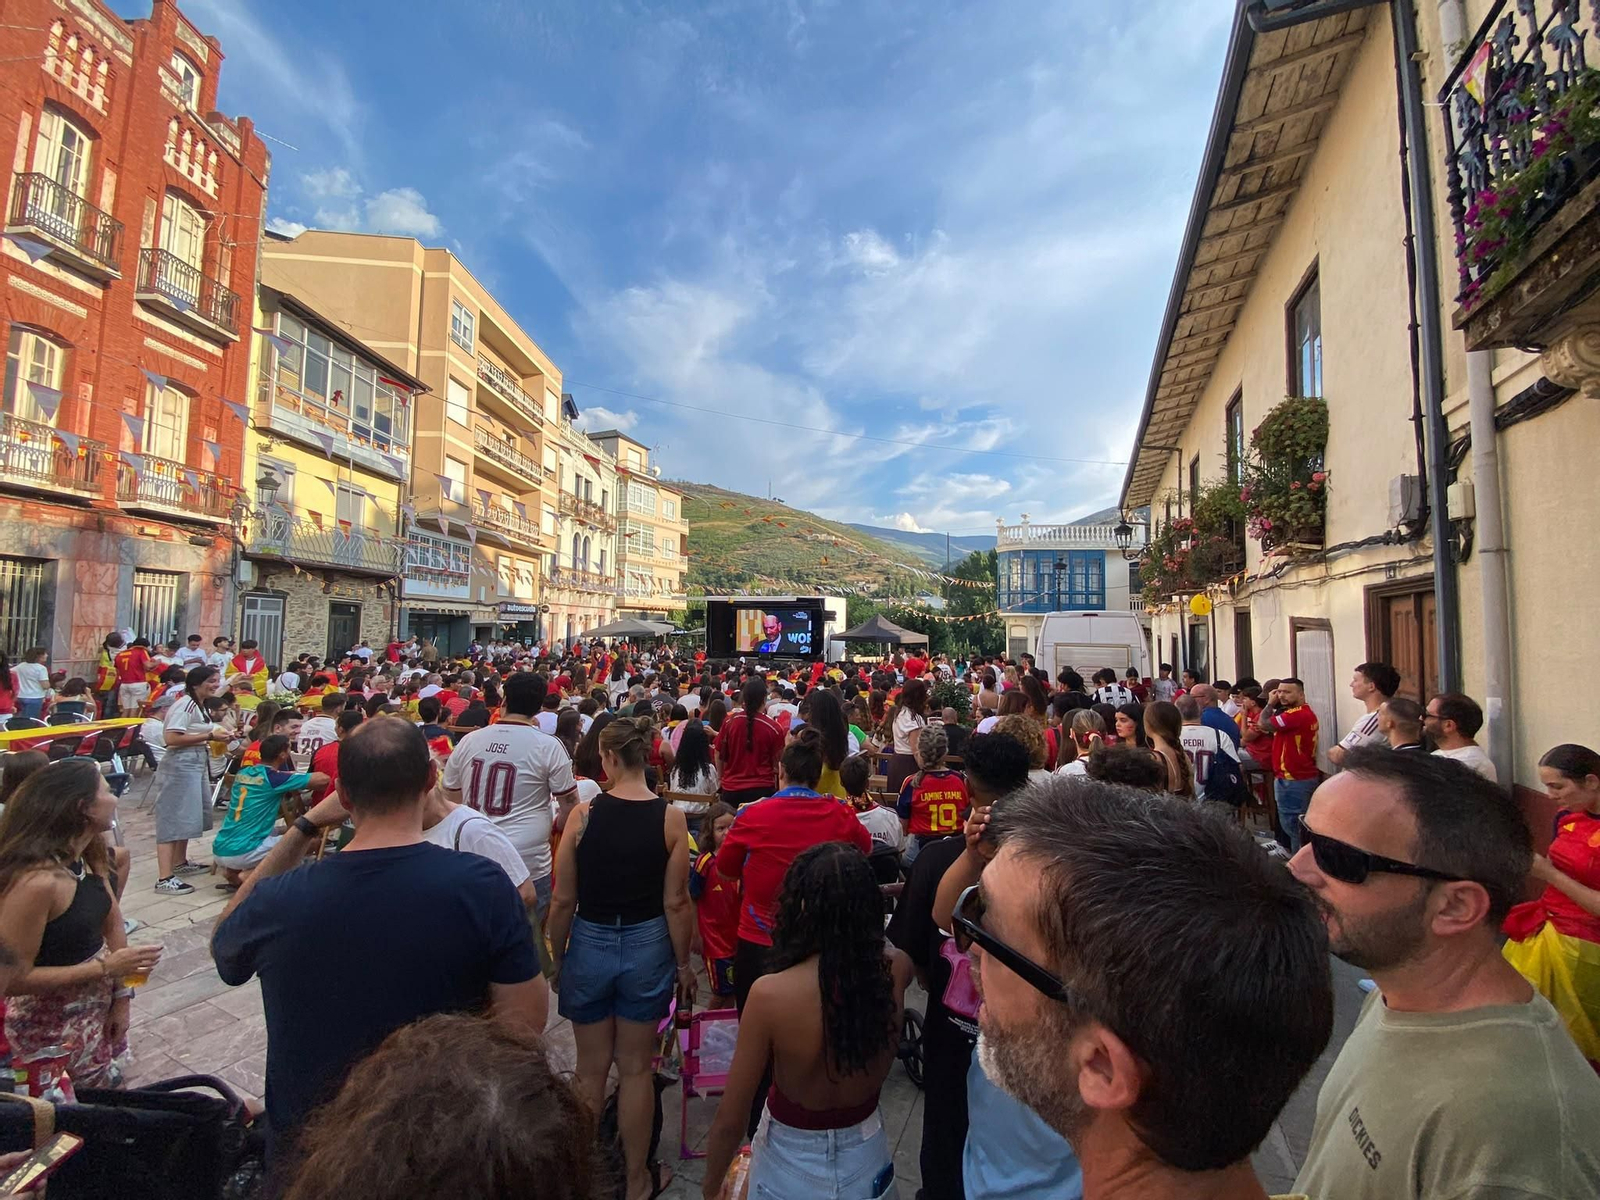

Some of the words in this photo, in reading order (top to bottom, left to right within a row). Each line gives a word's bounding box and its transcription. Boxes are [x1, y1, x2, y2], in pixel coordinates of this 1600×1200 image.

[485, 742, 510, 755] JOSE
[1183, 738, 1205, 748] PEDRI
[467, 757, 518, 816] 10
[920, 792, 943, 802] LAMINE
[943, 791, 963, 801] YAMAL
[928, 803, 958, 832] 19
[1348, 1106, 1382, 1171] DICKIES
